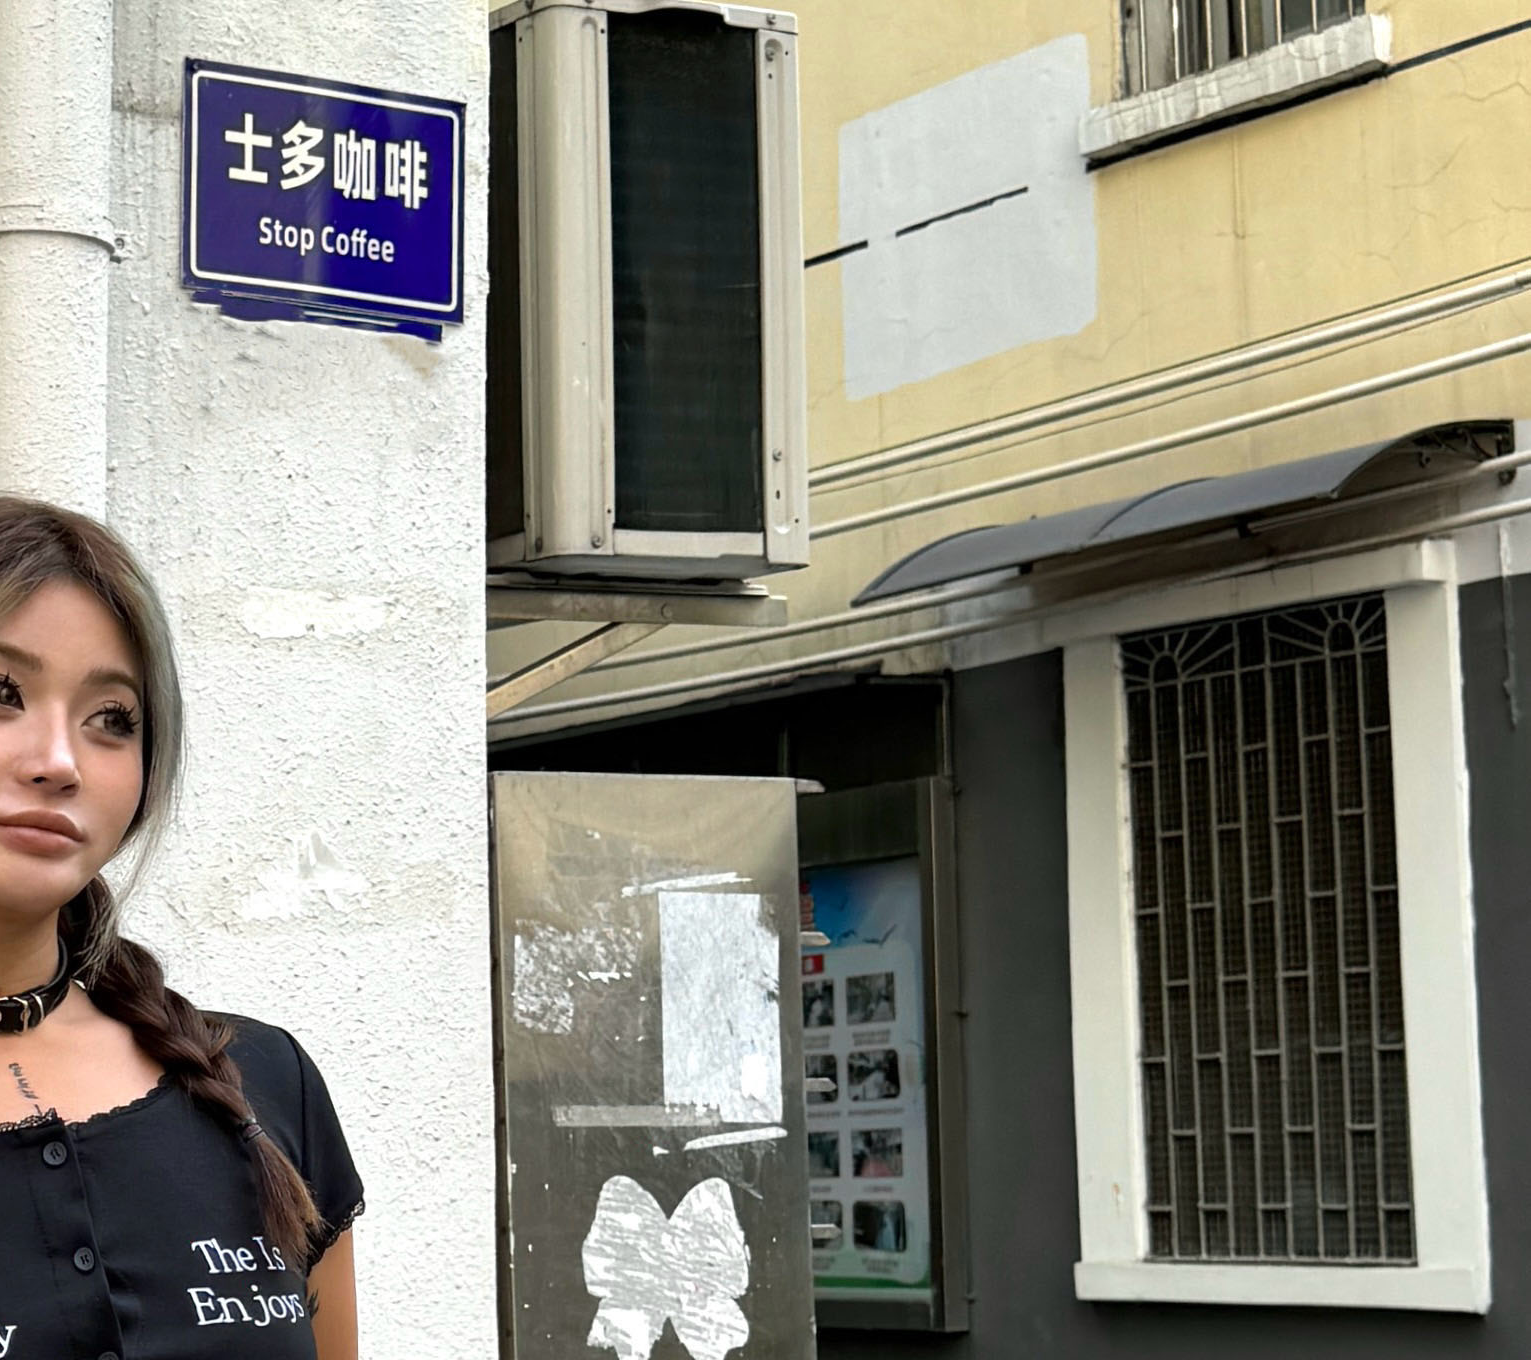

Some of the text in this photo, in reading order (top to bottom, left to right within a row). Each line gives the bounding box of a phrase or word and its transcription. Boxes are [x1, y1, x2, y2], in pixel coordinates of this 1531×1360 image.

[225, 113, 428, 209] 士多咖啡
[259, 217, 395, 262] Stop Coffee
[190, 1237, 257, 1274] The
[187, 1284, 305, 1327] Enjoys
